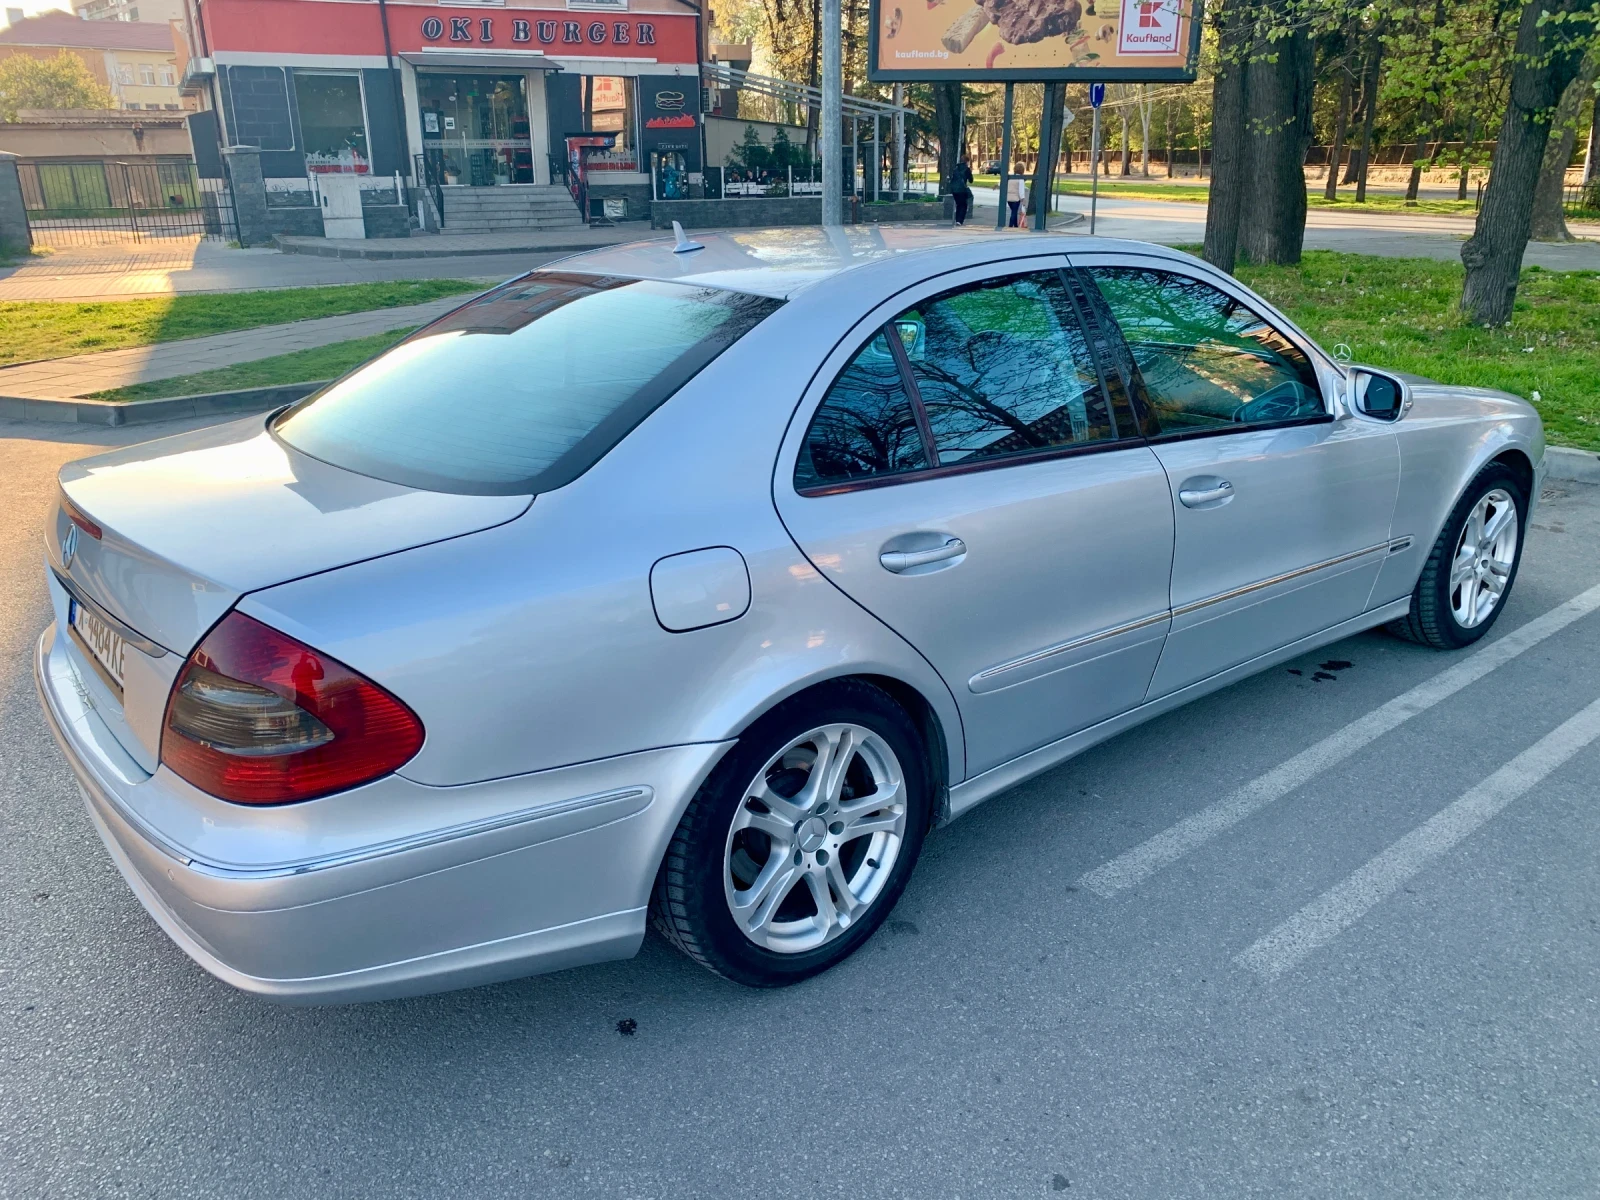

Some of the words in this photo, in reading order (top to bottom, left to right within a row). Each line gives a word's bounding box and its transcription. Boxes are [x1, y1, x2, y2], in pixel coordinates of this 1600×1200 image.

[421, 16, 494, 42] OKI
[512, 19, 656, 45] BURGER
[1126, 33, 1172, 43] Kaufland
[895, 49, 949, 59] kaufland.bg
